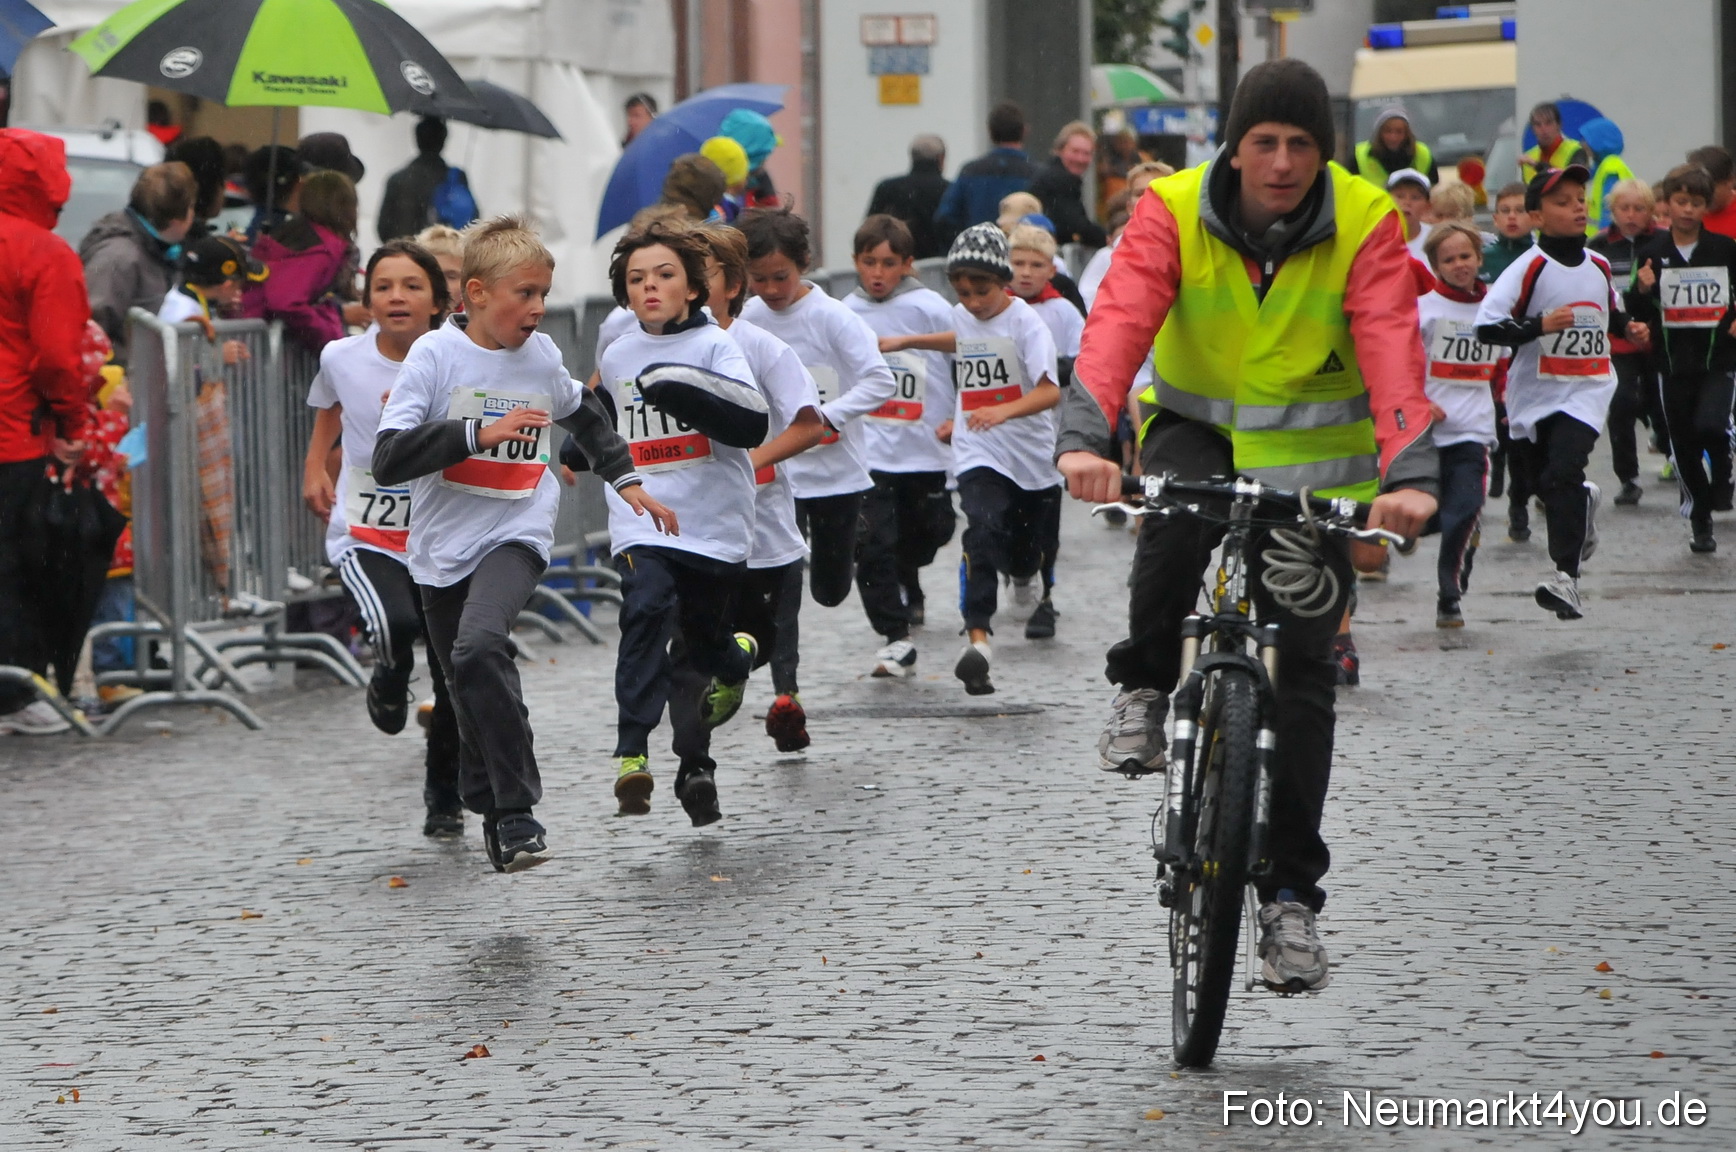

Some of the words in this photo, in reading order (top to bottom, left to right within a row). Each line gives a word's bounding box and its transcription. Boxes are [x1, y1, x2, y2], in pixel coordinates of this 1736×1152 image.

[252, 71, 347, 88] Kawasaki
[1668, 283, 1721, 305] 7102
[1442, 336, 1493, 362] 7081
[1551, 329, 1604, 356] 7238
[484, 398, 530, 411] BOCK
[638, 444, 682, 462] Tobias
[359, 492, 412, 527] 727
